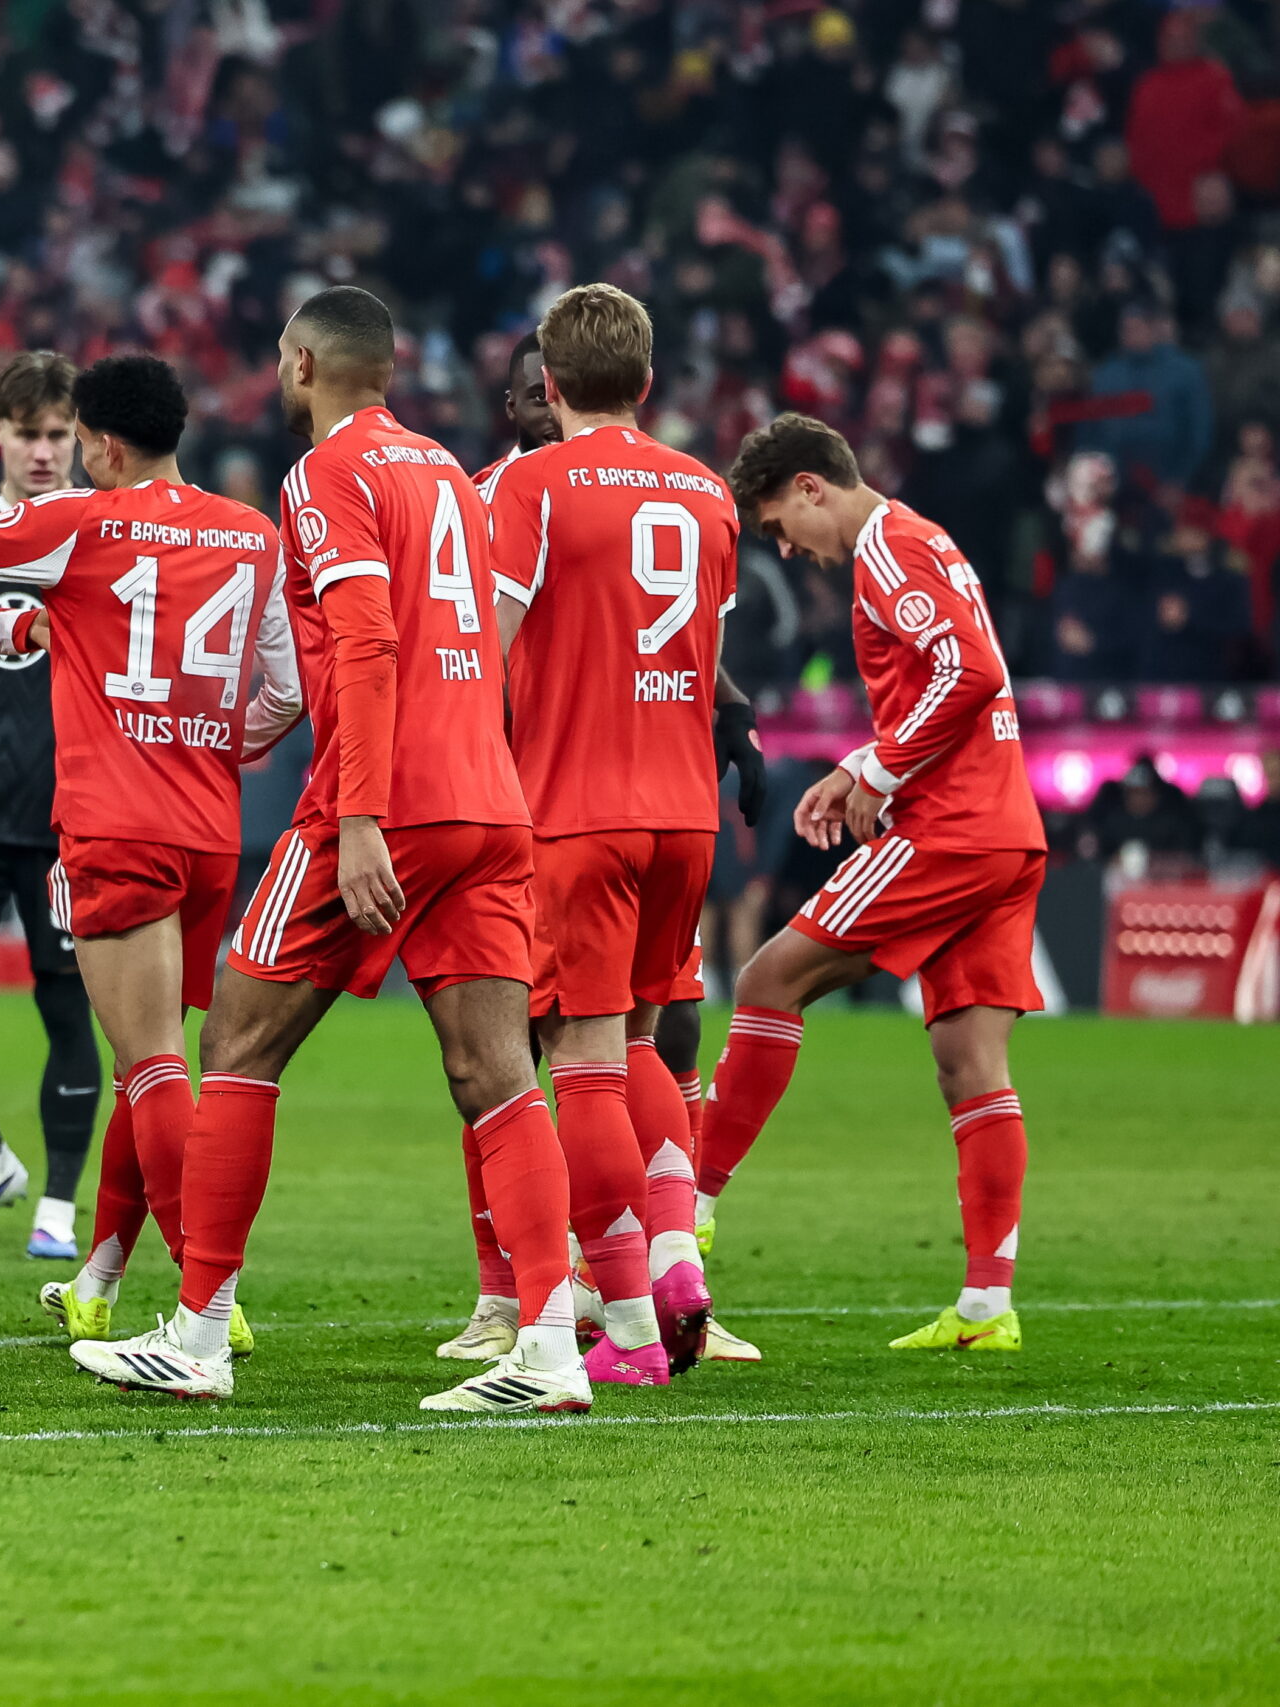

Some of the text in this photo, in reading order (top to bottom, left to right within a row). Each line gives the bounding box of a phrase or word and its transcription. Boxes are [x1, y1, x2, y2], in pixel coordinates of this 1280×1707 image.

[361, 449, 387, 468] FC
[380, 445, 428, 465] BAYERN
[568, 468, 724, 501] FC BAYERN MÜNCHEN
[100, 519, 266, 551] FC BAYERN MÜNCHEN
[429, 479, 481, 633] 4
[631, 501, 700, 655] 9
[105, 555, 255, 710] 14
[914, 617, 955, 653] Allianz
[435, 647, 482, 681] TAH
[634, 671, 697, 702] KANE
[115, 709, 232, 751] LUIS DÍAZ
